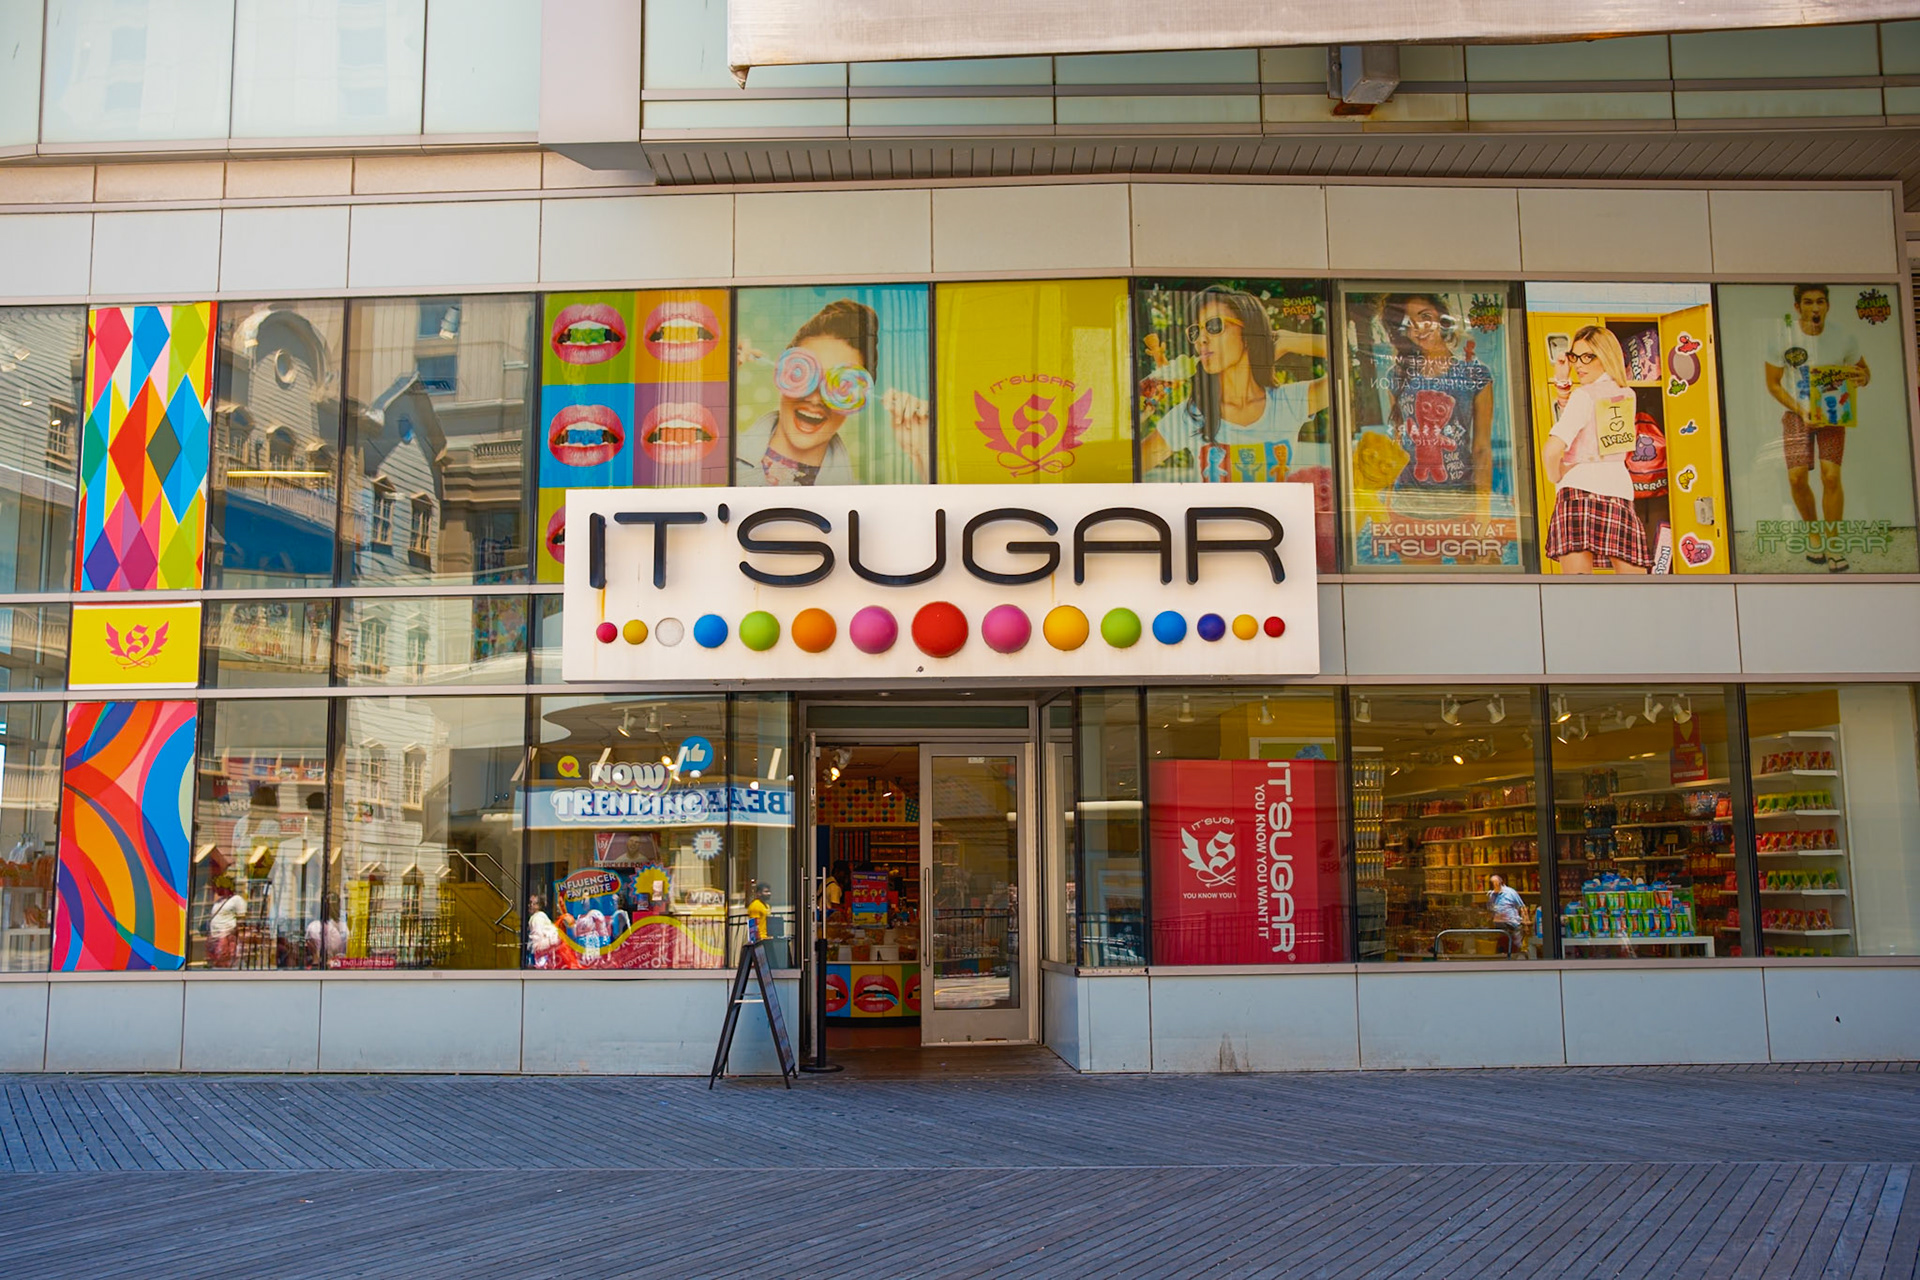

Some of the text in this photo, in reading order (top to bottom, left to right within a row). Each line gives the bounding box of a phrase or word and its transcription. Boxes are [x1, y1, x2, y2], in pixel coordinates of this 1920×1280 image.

[1283, 296, 1313, 307] SOUR
[1283, 305, 1316, 316] PATCH
[1857, 297, 1888, 309] SOUR
[1857, 307, 1891, 320] PATCH
[990, 373, 1076, 395] IT'SUGAR
[1608, 406, 1622, 420] I
[1372, 523, 1506, 536] EXCLUSIVELY AT
[1757, 520, 1891, 534] EXCLUSIVELY AT
[589, 503, 1285, 589] IT'SUGAR
[1372, 539, 1503, 556] IT'SUGAR
[1757, 536, 1889, 554] IT'SUGAR
[591, 763, 667, 790] NOW
[553, 790, 705, 817] TRENDING
[1255, 784, 1269, 939] YOU KNOW YOU WANT IT
[1267, 761, 1296, 953] IT'SUGAR
[555, 872, 616, 892] INFLUENCER
[567, 882, 612, 900] FAVORITE
